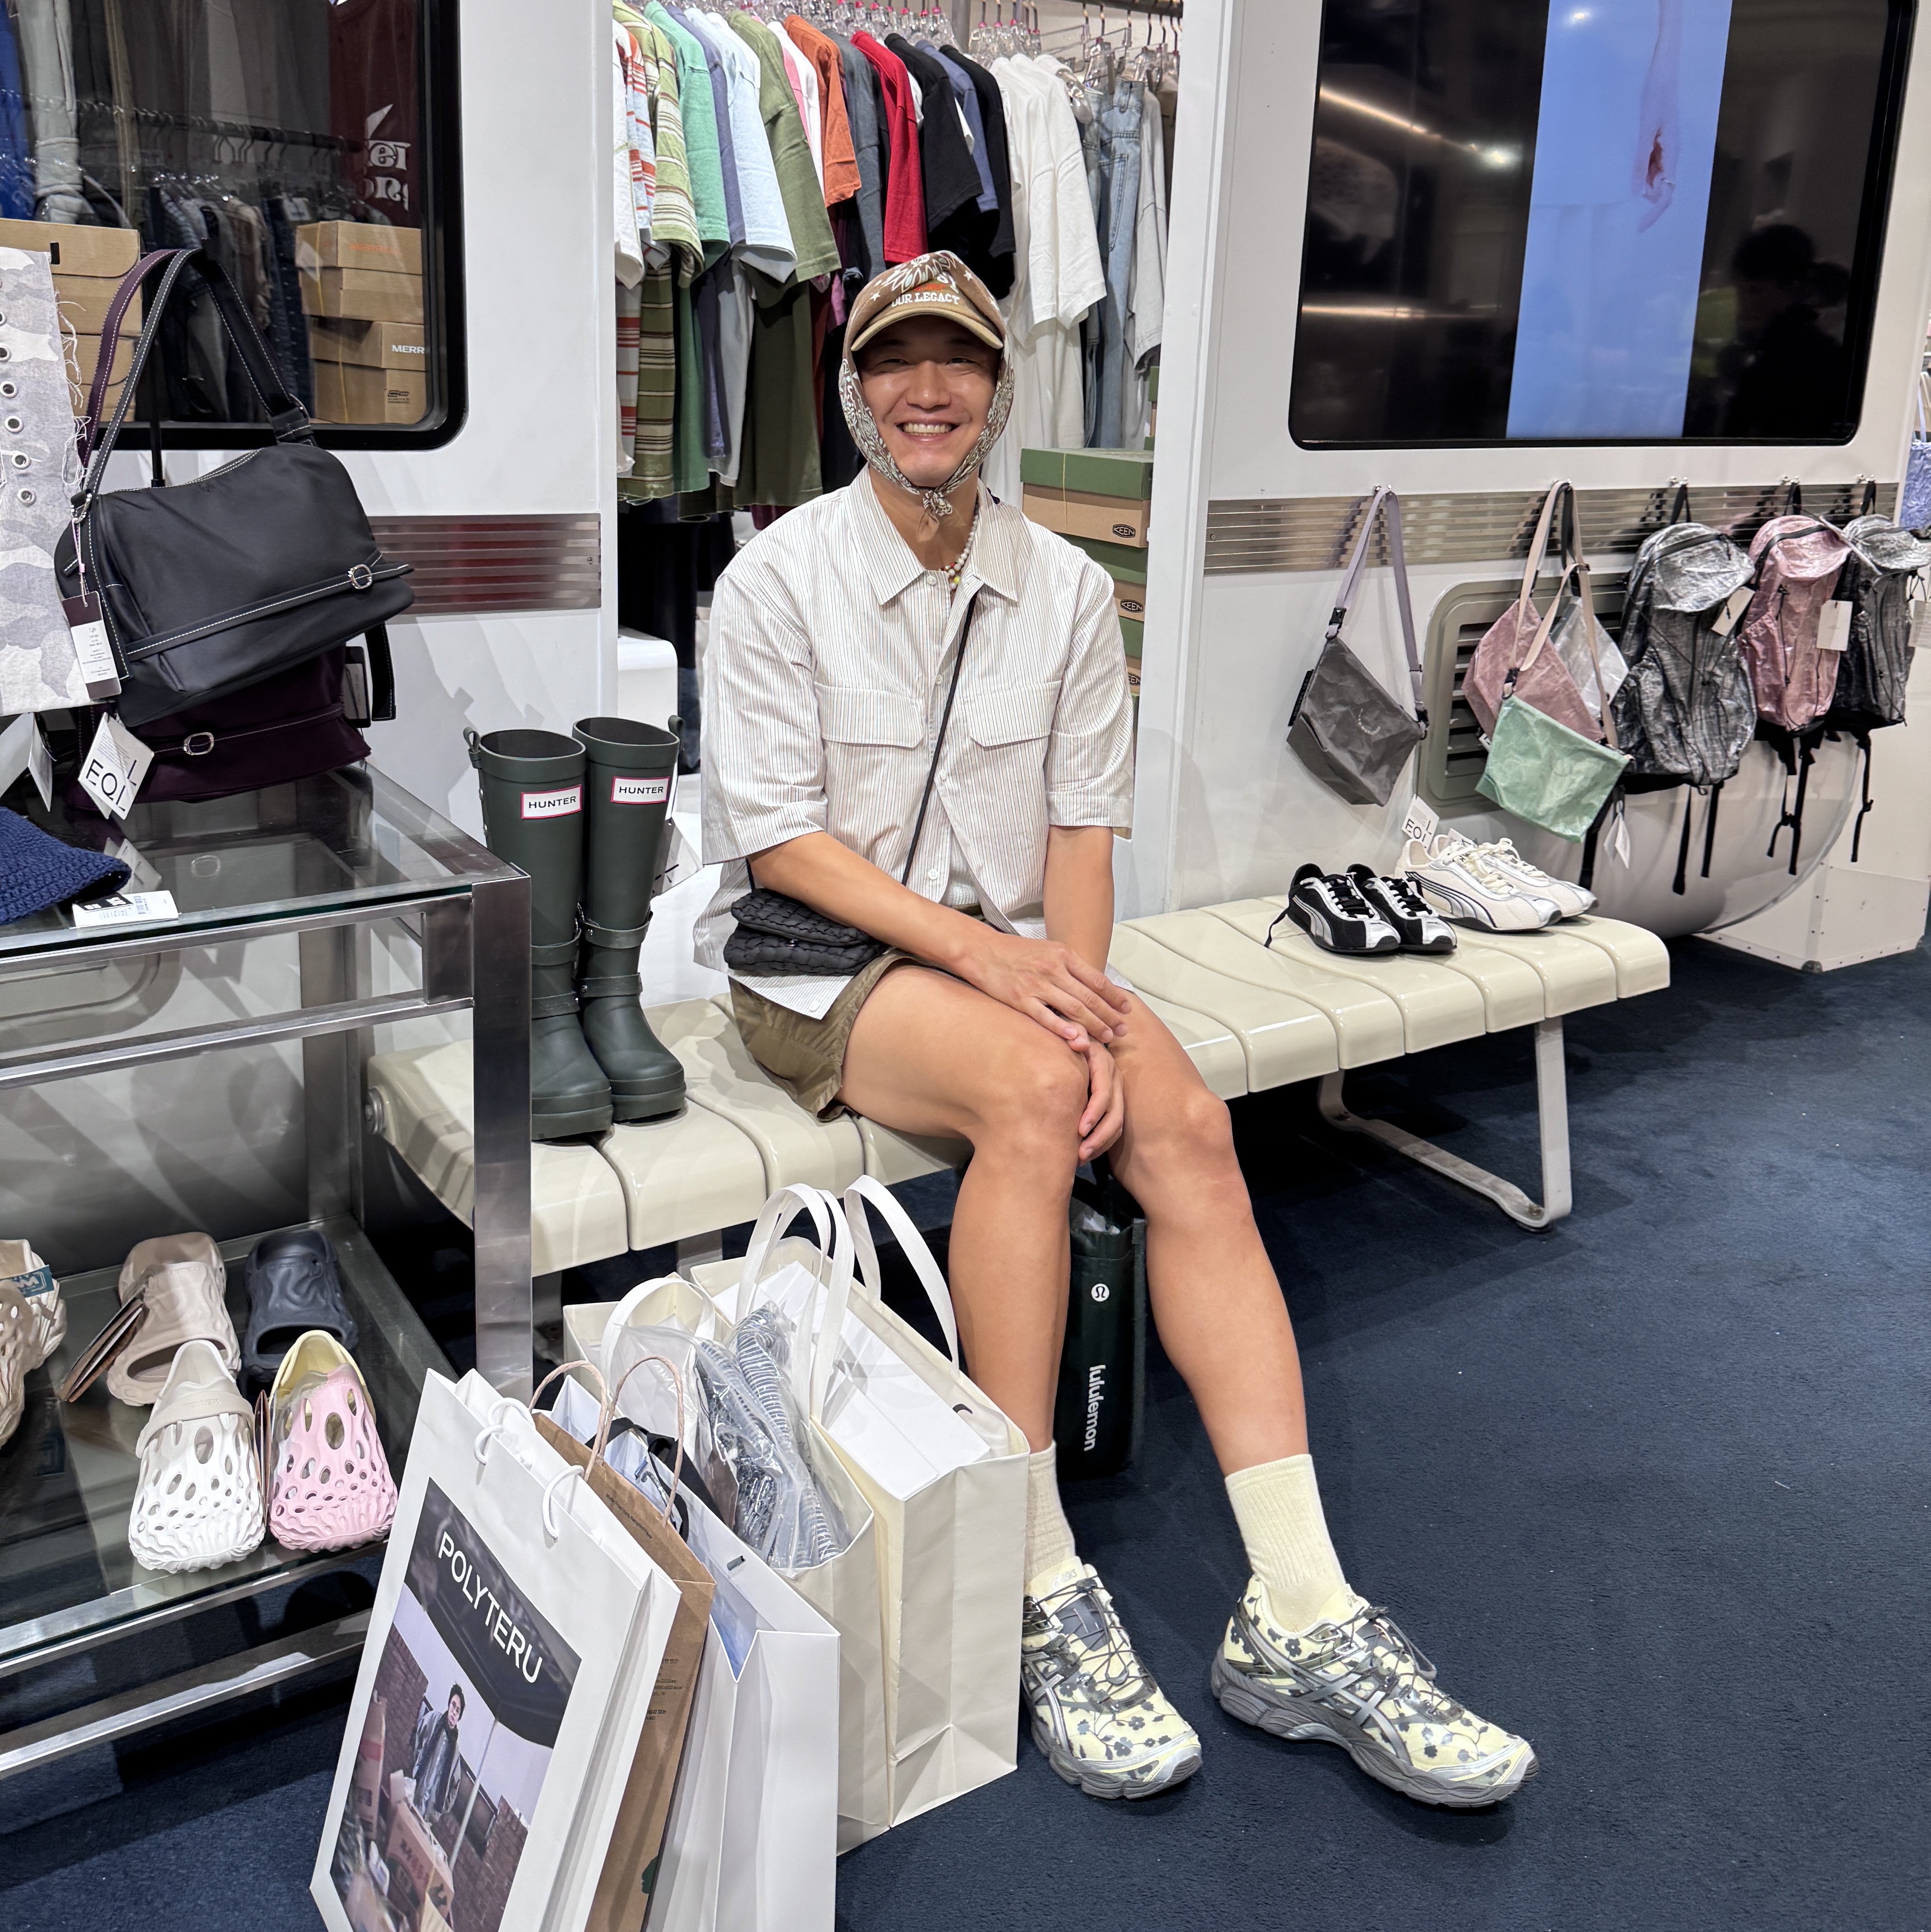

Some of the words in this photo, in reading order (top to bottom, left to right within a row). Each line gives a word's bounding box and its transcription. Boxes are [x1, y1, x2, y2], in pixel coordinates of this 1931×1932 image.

[915, 292, 960, 305] LEGACY
[1114, 526, 1135, 536] KEEN
[1122, 602, 1143, 610] KEEN
[86, 758, 126, 812] EQL
[619, 786, 664, 794] HUNTER
[528, 795, 576, 808] HUNTER
[1083, 1364, 1106, 1452] lululemon
[438, 1531, 543, 1684] POLYTERU
